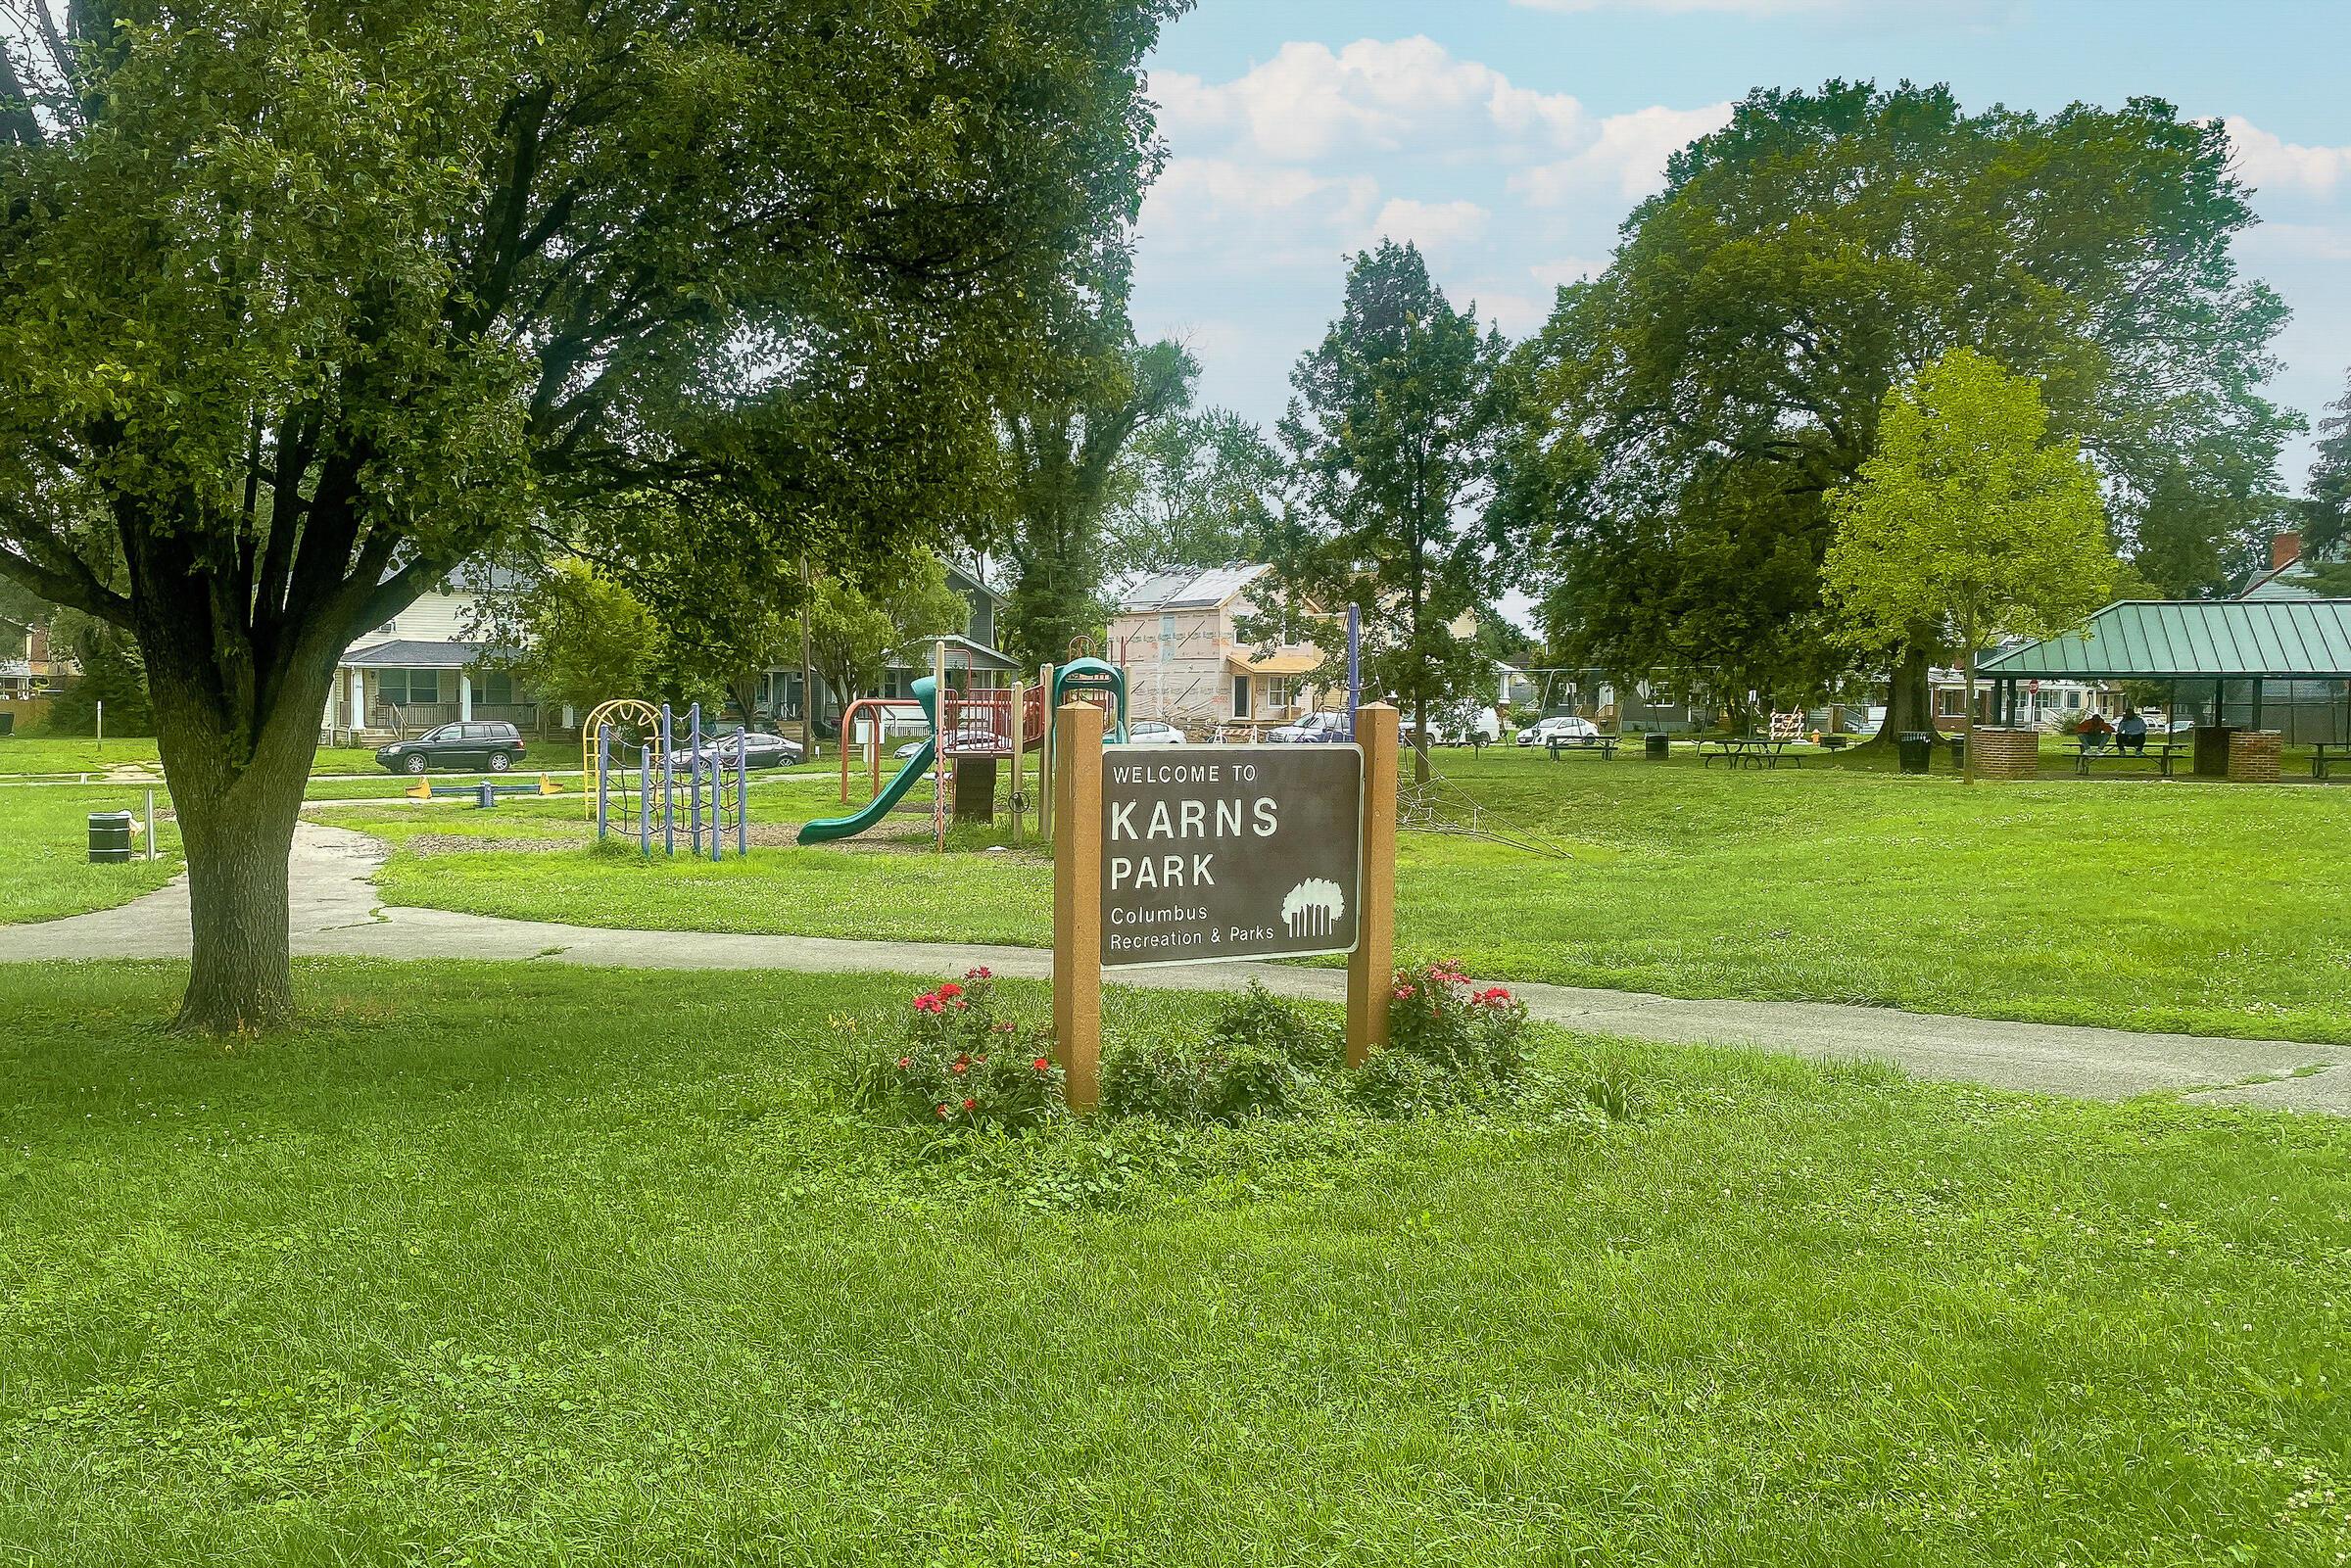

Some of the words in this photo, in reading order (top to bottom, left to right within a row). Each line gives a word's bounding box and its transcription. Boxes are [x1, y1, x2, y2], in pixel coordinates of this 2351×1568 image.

[1114, 764, 1221, 784] WELCOME
[1232, 763, 1258, 783] TO
[1111, 796, 1278, 840] KARNS
[1111, 854, 1215, 890] PARK
[1111, 905, 1208, 925] Columbus
[1111, 928, 1203, 950] Recreation
[1210, 927, 1222, 942] &
[1230, 926, 1274, 941] Parks
